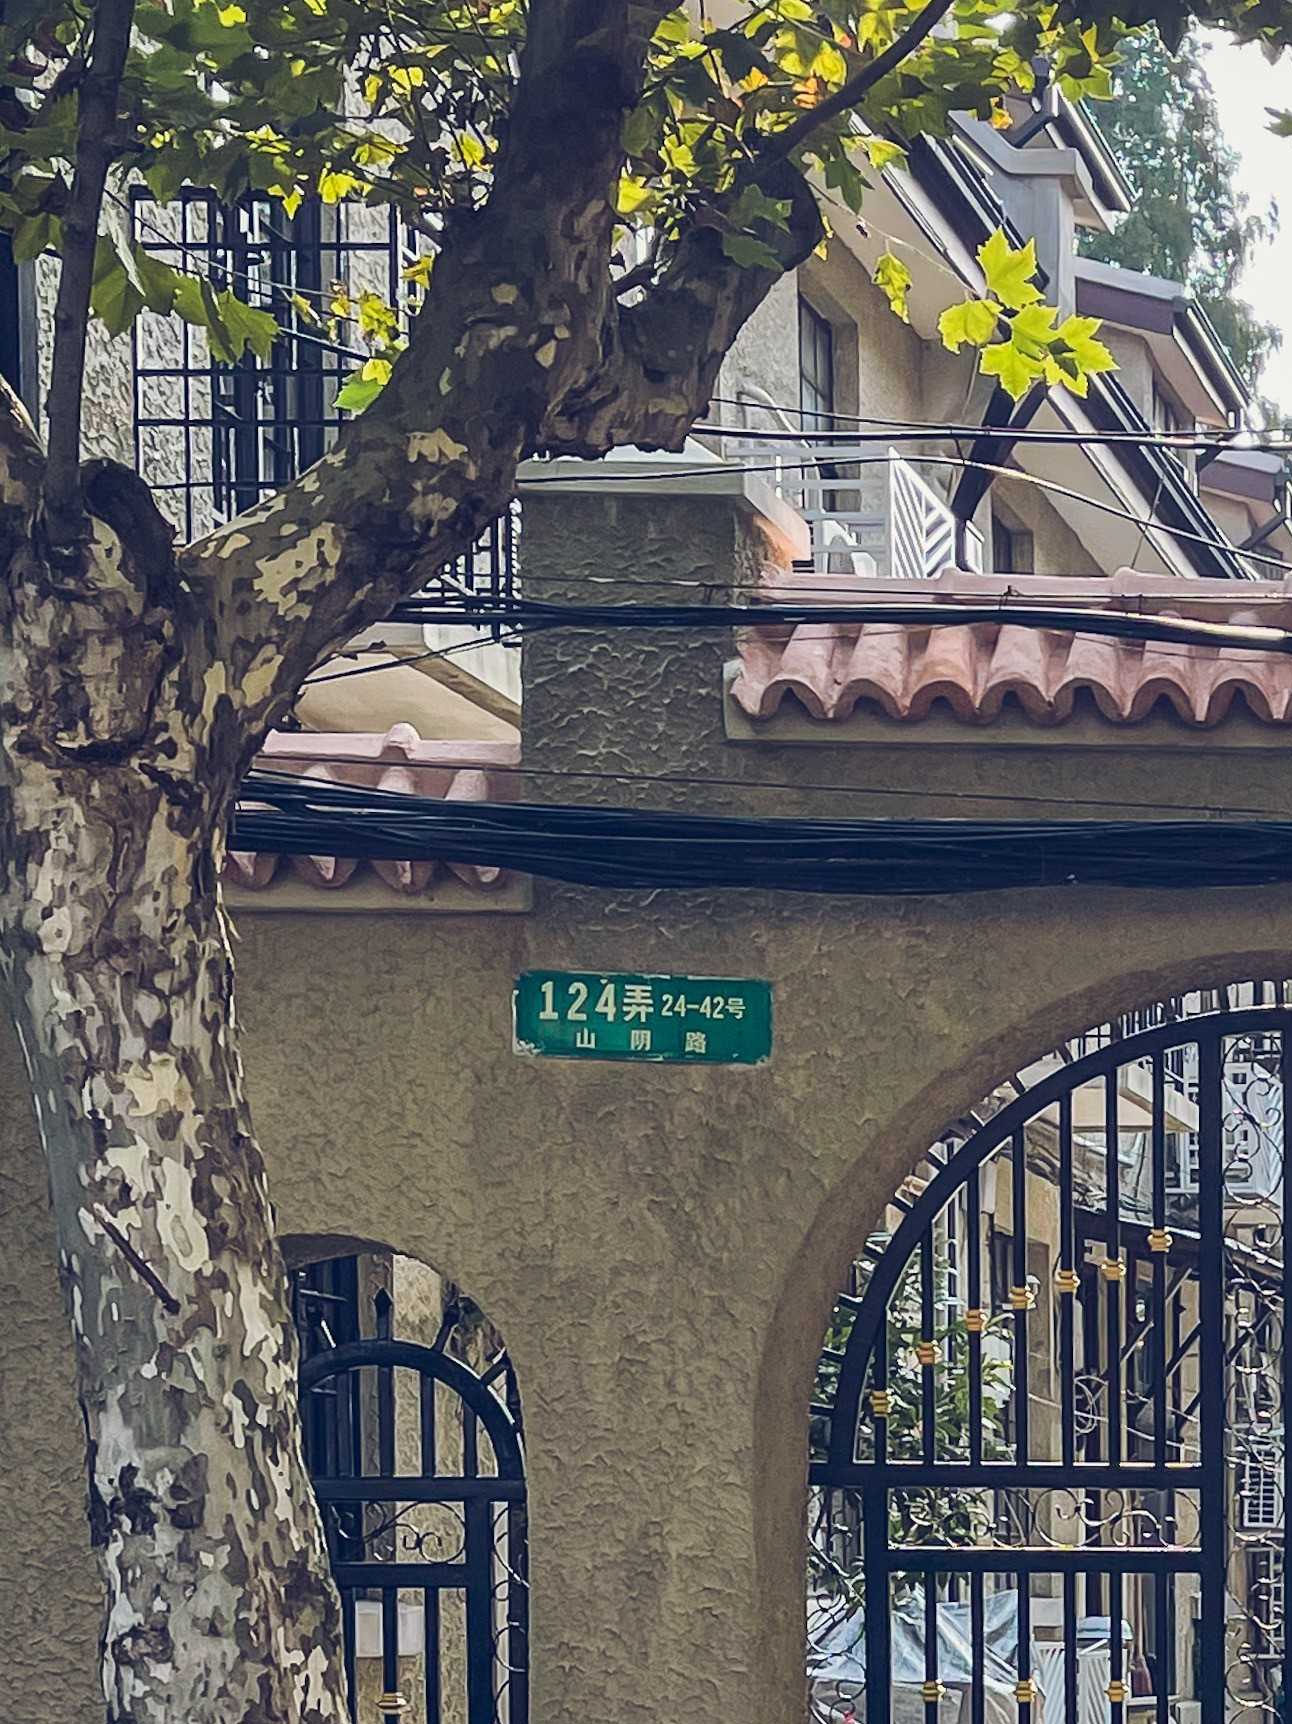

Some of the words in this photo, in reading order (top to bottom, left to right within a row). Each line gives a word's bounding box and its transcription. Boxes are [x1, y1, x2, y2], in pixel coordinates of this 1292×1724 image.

[539, 981, 654, 1023] 124弄
[661, 994, 746, 1020] 24-42号
[575, 1027, 706, 1054] 山阴路
